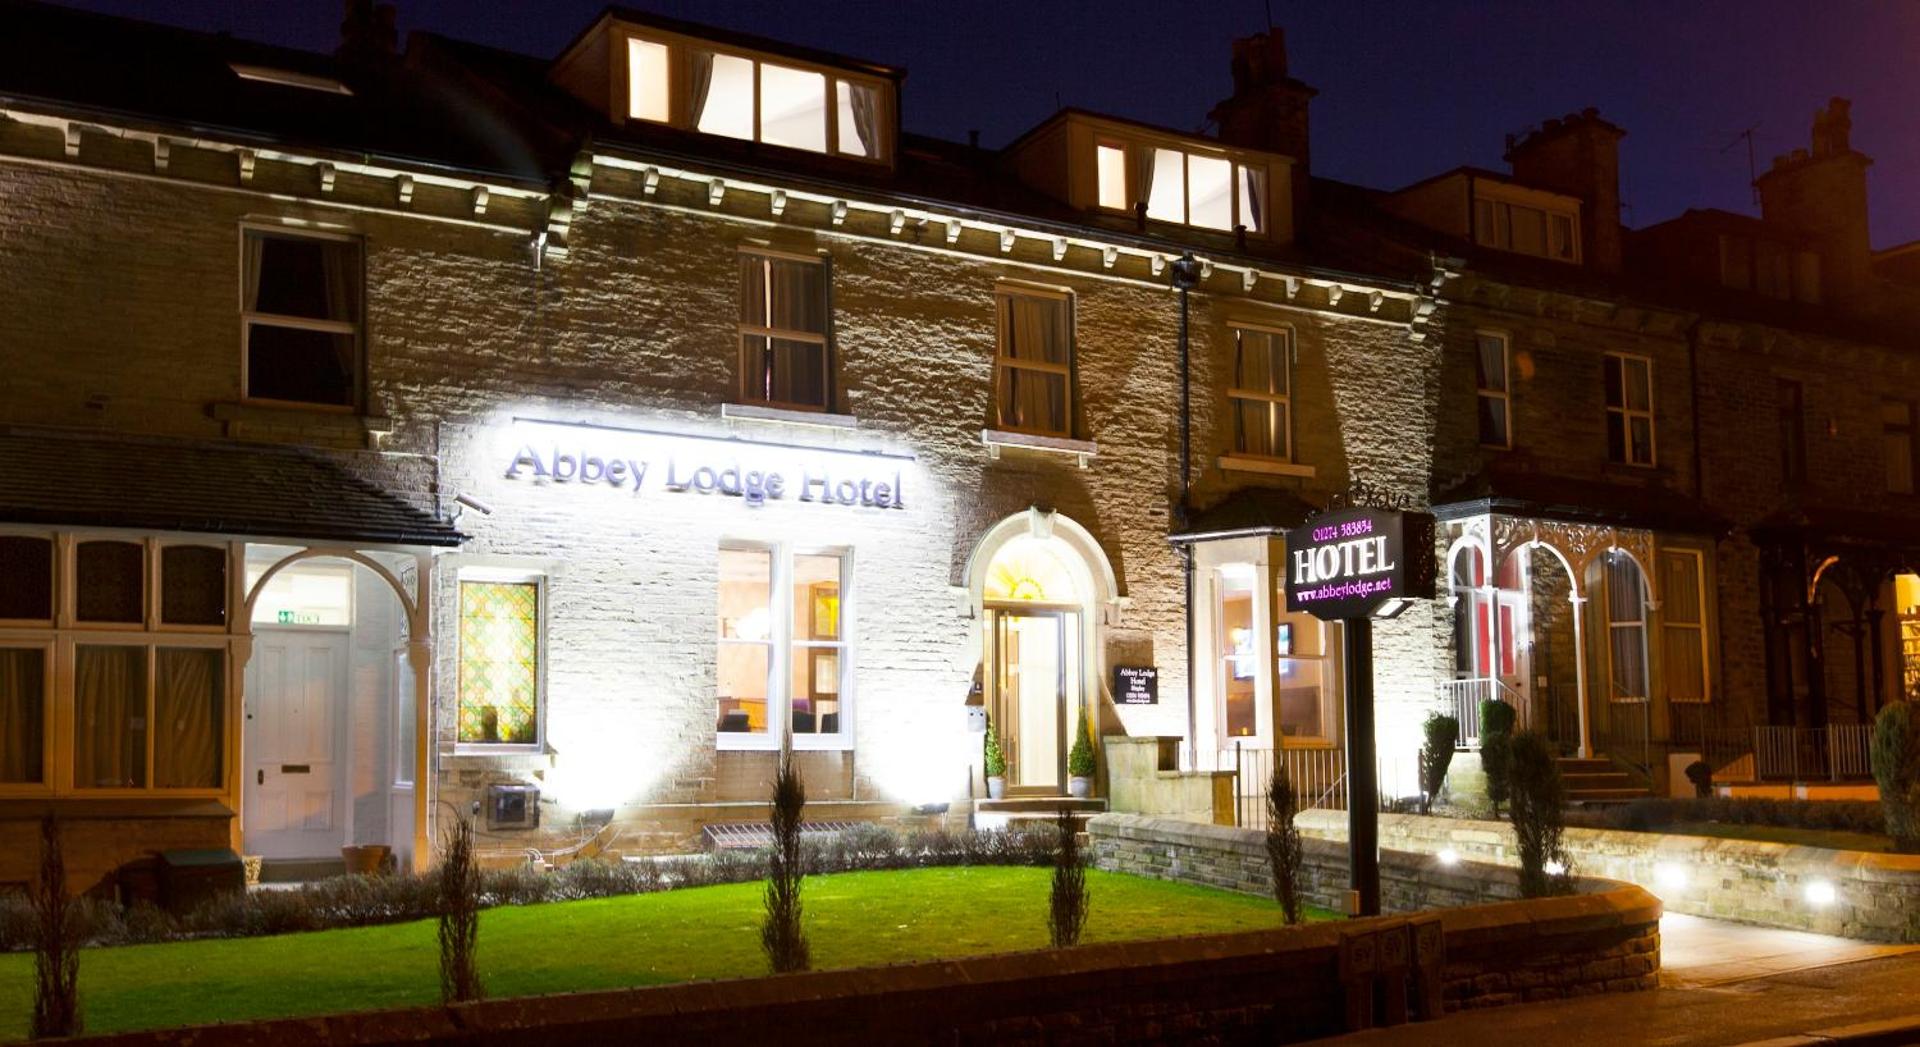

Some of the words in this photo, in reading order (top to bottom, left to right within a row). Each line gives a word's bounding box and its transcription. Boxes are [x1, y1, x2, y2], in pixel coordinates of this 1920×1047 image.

[506, 443, 649, 492] Abbey
[665, 453, 786, 506] Lodge
[799, 466, 904, 509] Hotel
[1312, 526, 1338, 542] 01274
[1293, 535, 1395, 585] HOTEL
[1297, 577, 1392, 602] www.abbeylodge.net
